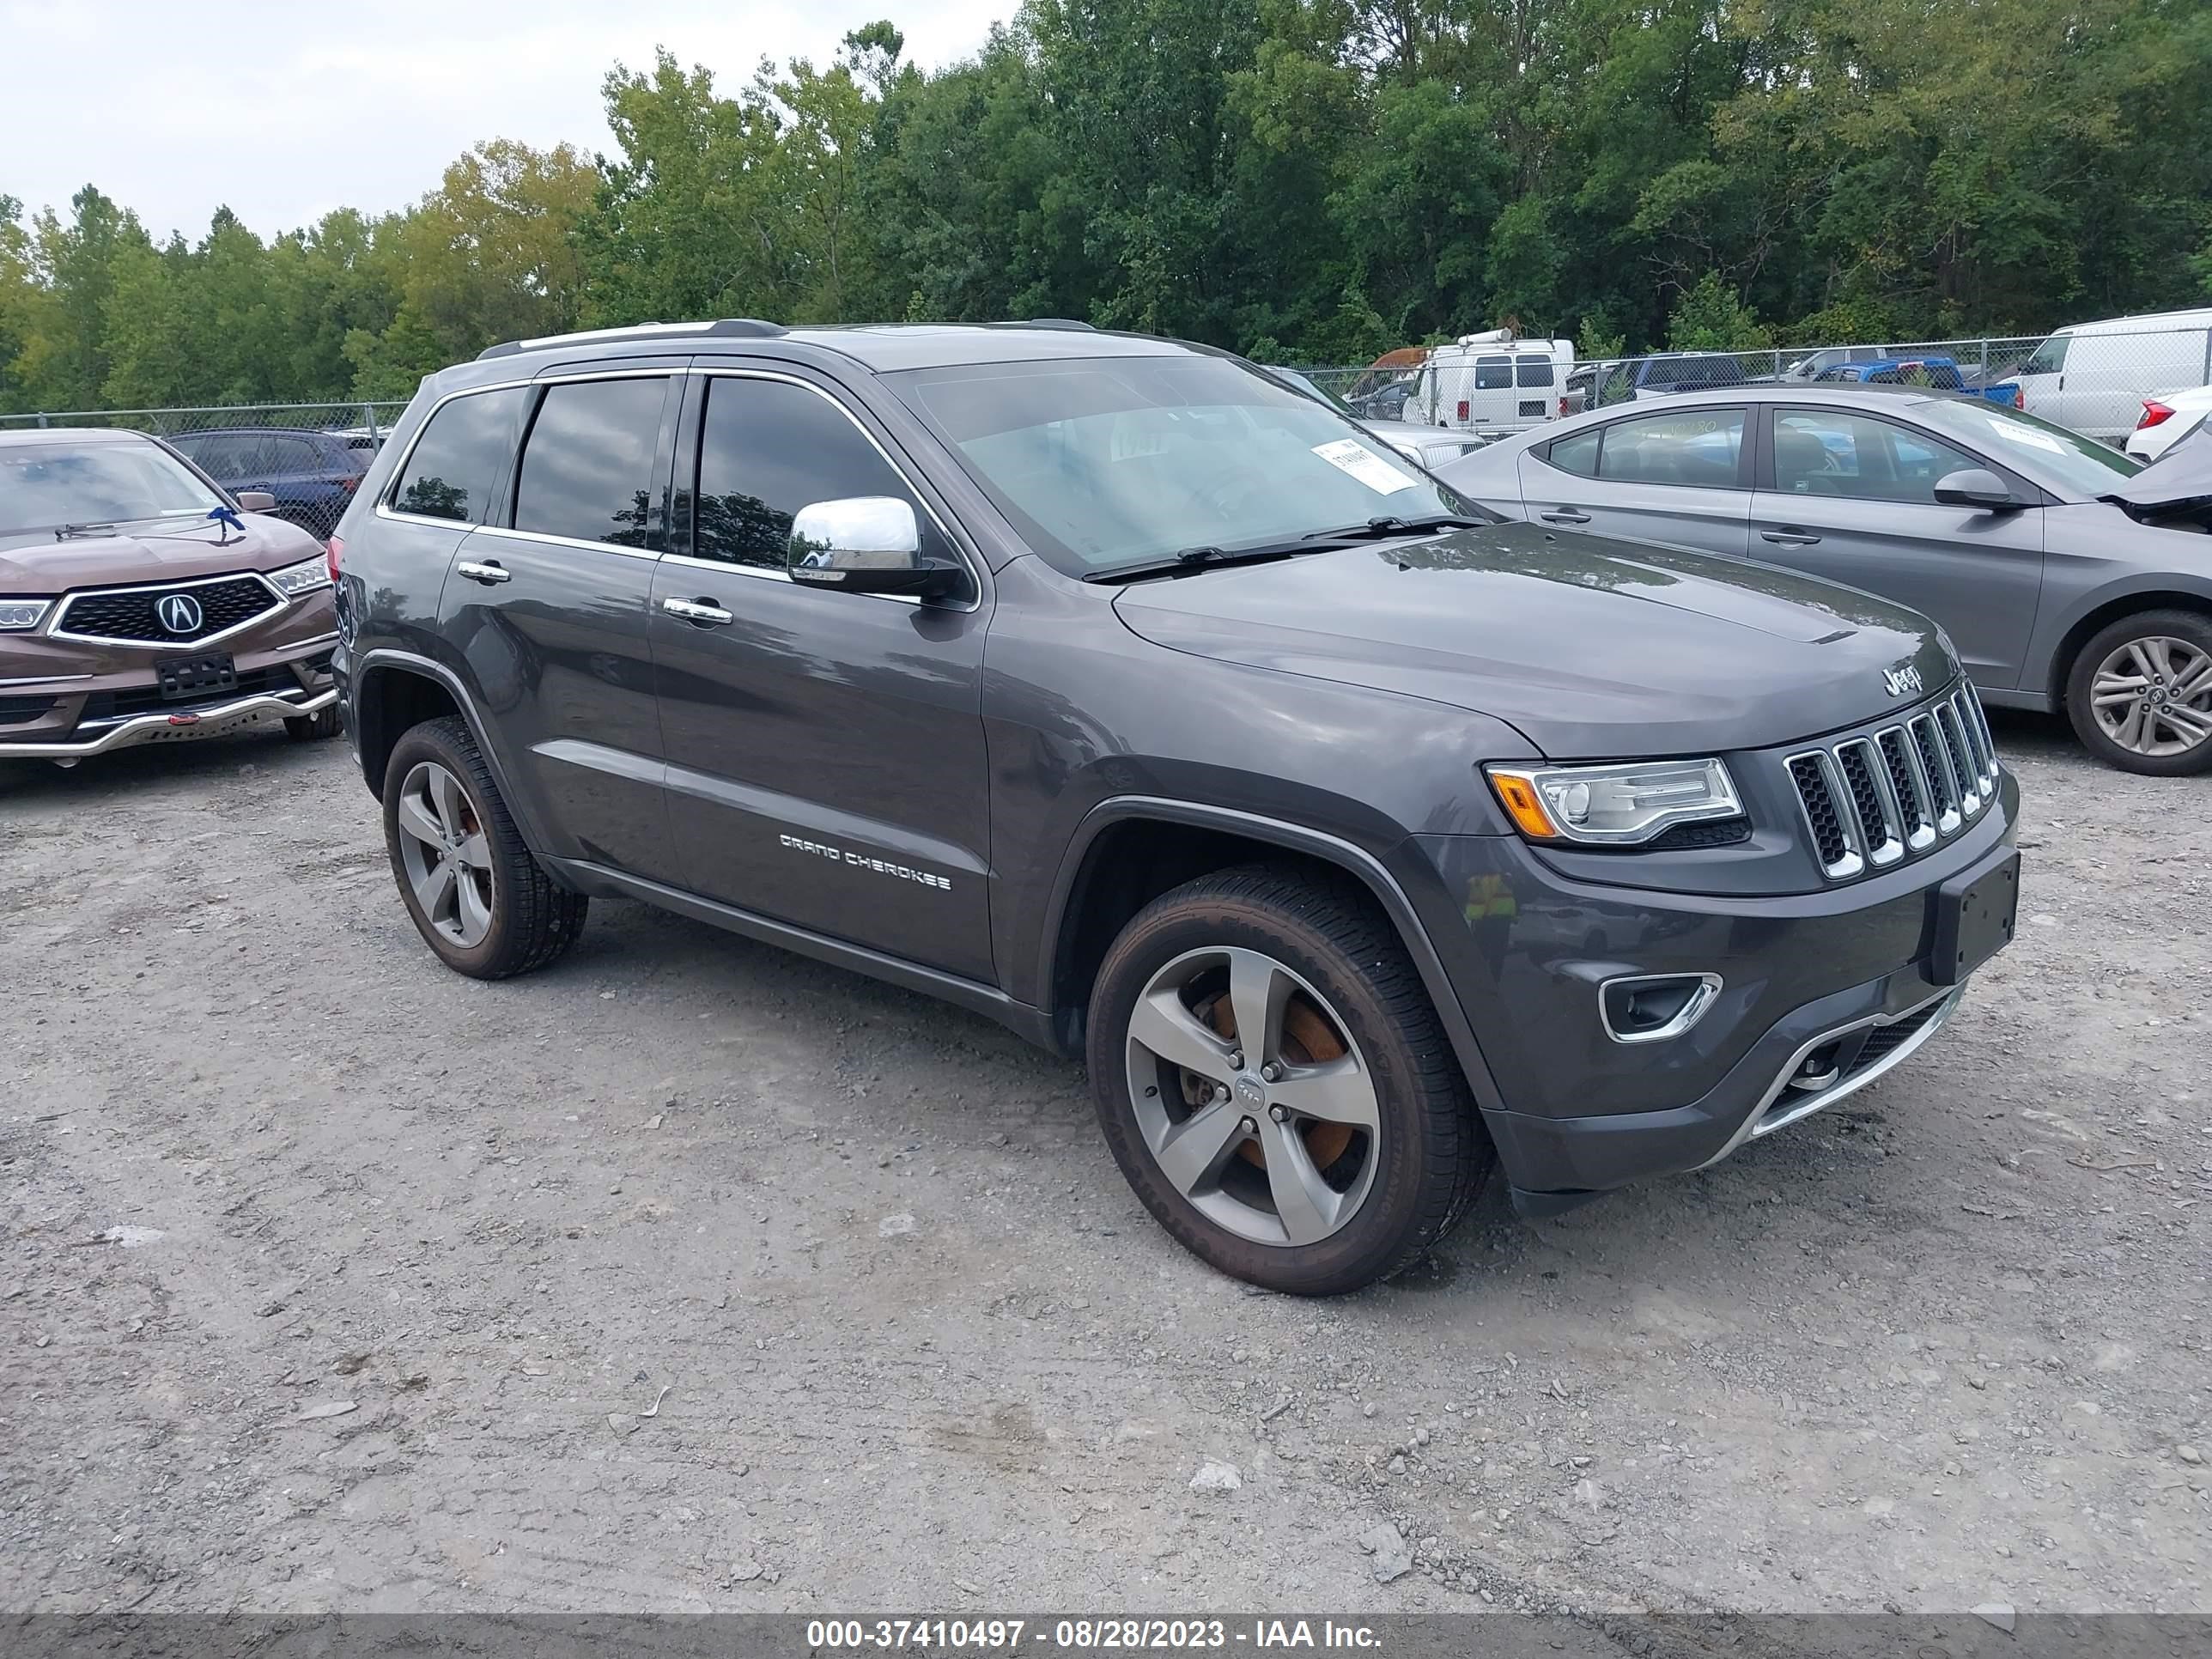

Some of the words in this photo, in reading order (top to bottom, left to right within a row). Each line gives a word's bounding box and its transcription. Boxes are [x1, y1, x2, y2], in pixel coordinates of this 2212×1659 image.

[1881, 665, 1923, 697] Jeep
[779, 834, 841, 860] GRAND
[844, 852, 952, 890] CHEROKEE
